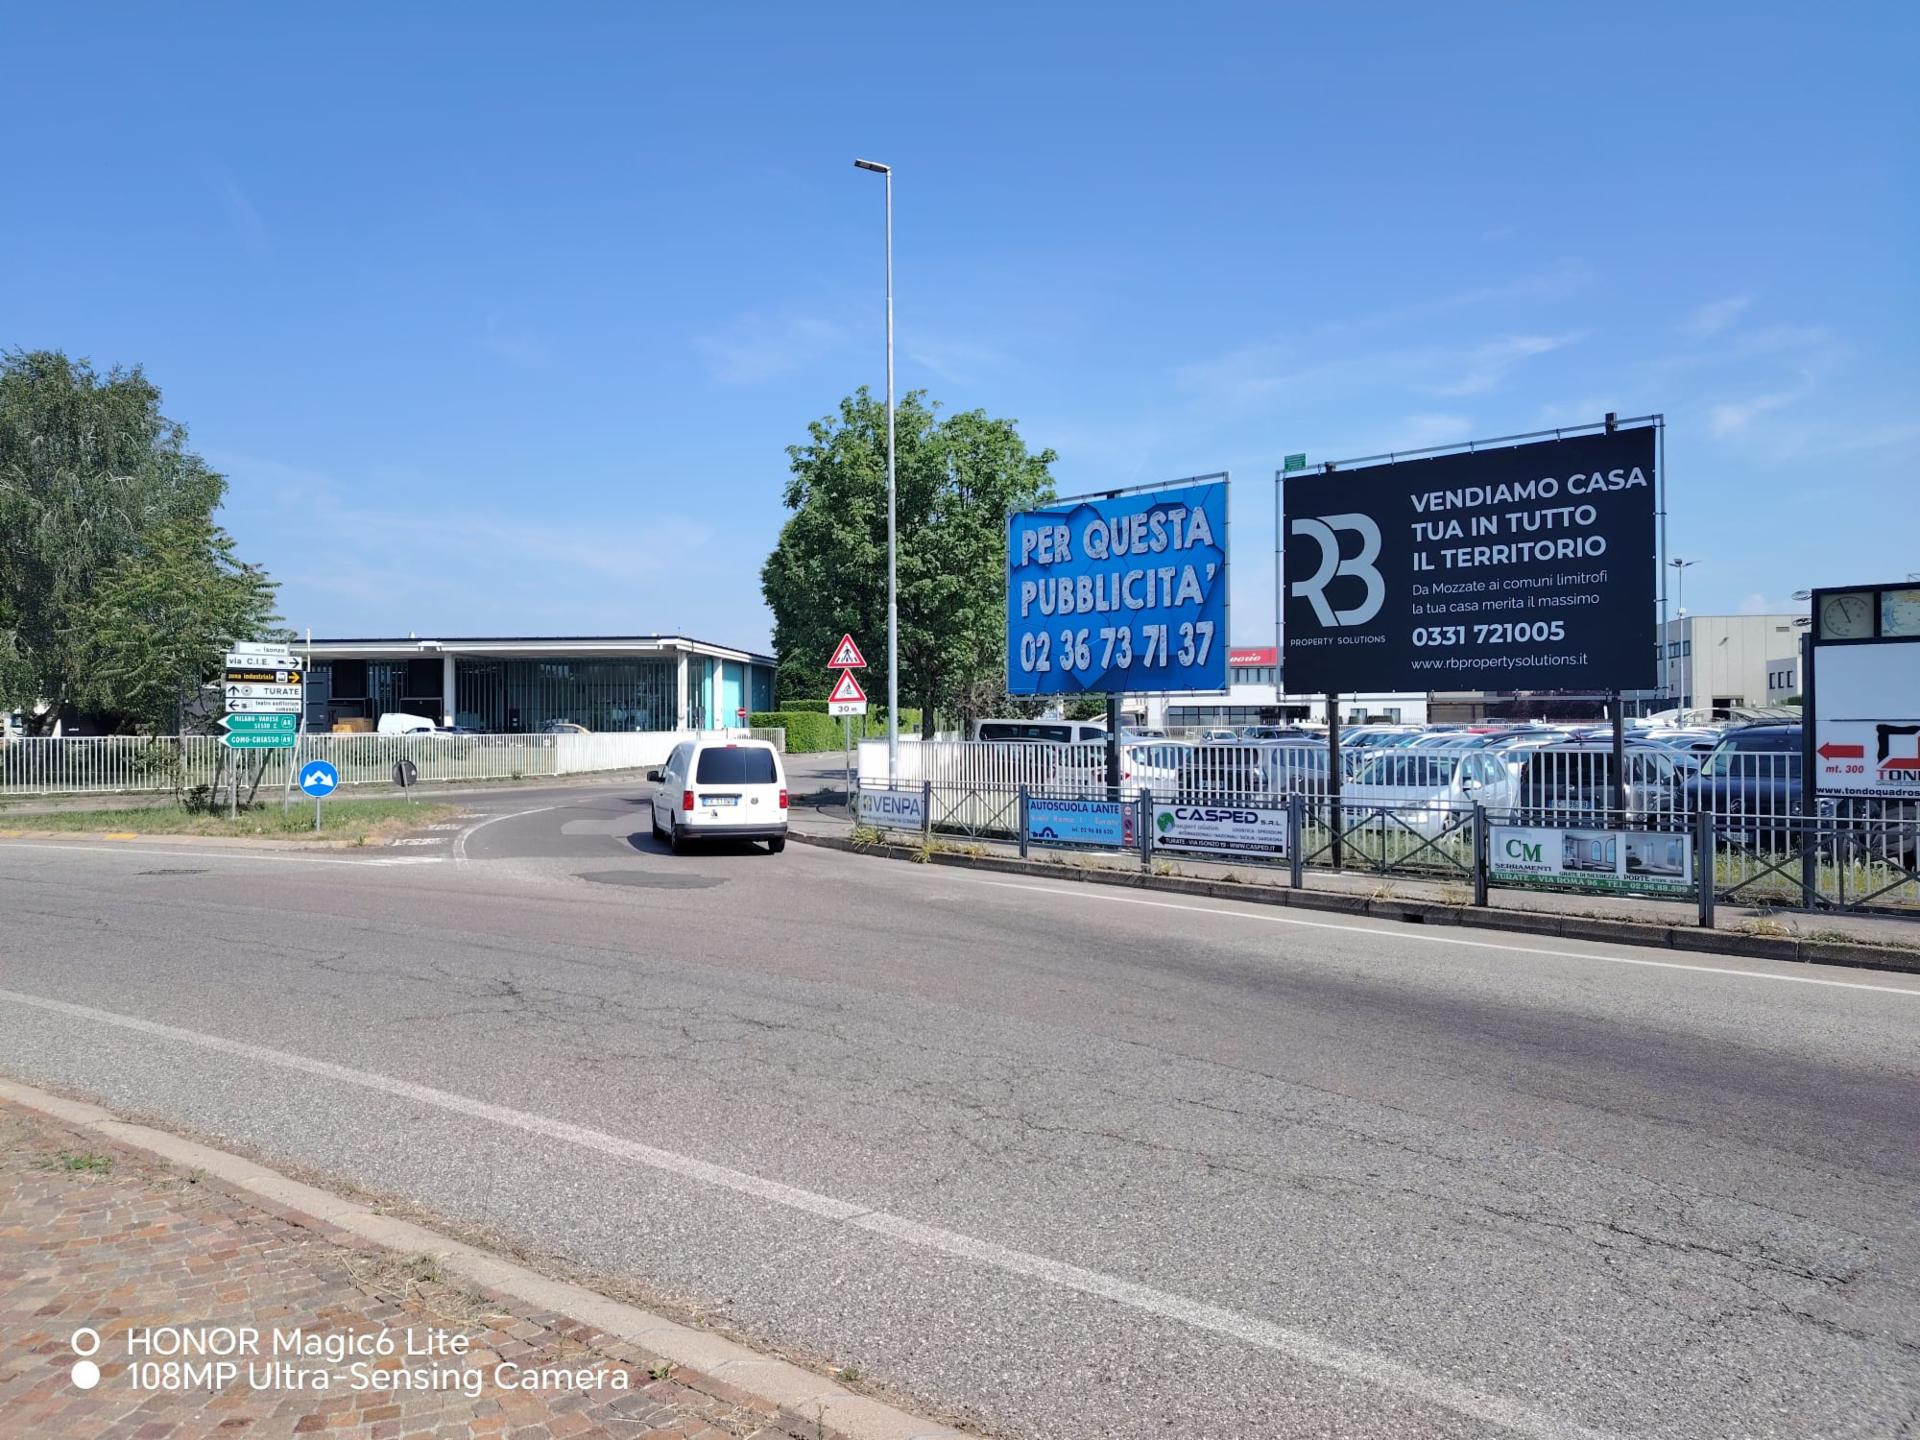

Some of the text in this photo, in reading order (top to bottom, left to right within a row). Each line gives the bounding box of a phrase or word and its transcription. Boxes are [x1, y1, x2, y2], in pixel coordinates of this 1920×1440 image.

[1410, 466, 1647, 513] VENDIAMO CASA
[1411, 504, 1597, 542] TUA IN TUTTO
[1021, 506, 1214, 567] PER QUESTA
[1413, 535, 1607, 571] IL TERRITORIO
[1021, 563, 1216, 617] PUBBLICITA'
[1412, 570, 1608, 597] Da Mozzate ai comuni limitrofi
[1412, 593, 1600, 616] la tua casa merita il massimo
[1290, 635, 1386, 647] PROPERTY SOLUTIONS
[1412, 620, 1566, 647] 0331 721005
[1020, 621, 1214, 672] 02 36 73 71 37
[1411, 653, 1588, 671] www.rbpropertysolutions.it
[243, 672, 274, 680] industriale
[264, 687, 300, 695] TURATE
[1825, 765, 1864, 774] mt. 300
[1876, 769, 1920, 781] TON
[873, 795, 921, 816] VENPA
[1030, 801, 1119, 814] AUTOSCUOLA LANTE
[1175, 808, 1258, 824] CASPED
[1165, 837, 1185, 845] TURATE
[1230, 842, 1276, 852] WWW.CASPED.IT
[1505, 839, 1543, 863] CM
[1495, 863, 1552, 872] SERRAMENTI
[1495, 873, 1528, 881] TURATE
[1556, 877, 1585, 886] ROMA
[1624, 874, 1650, 882] PORTE
